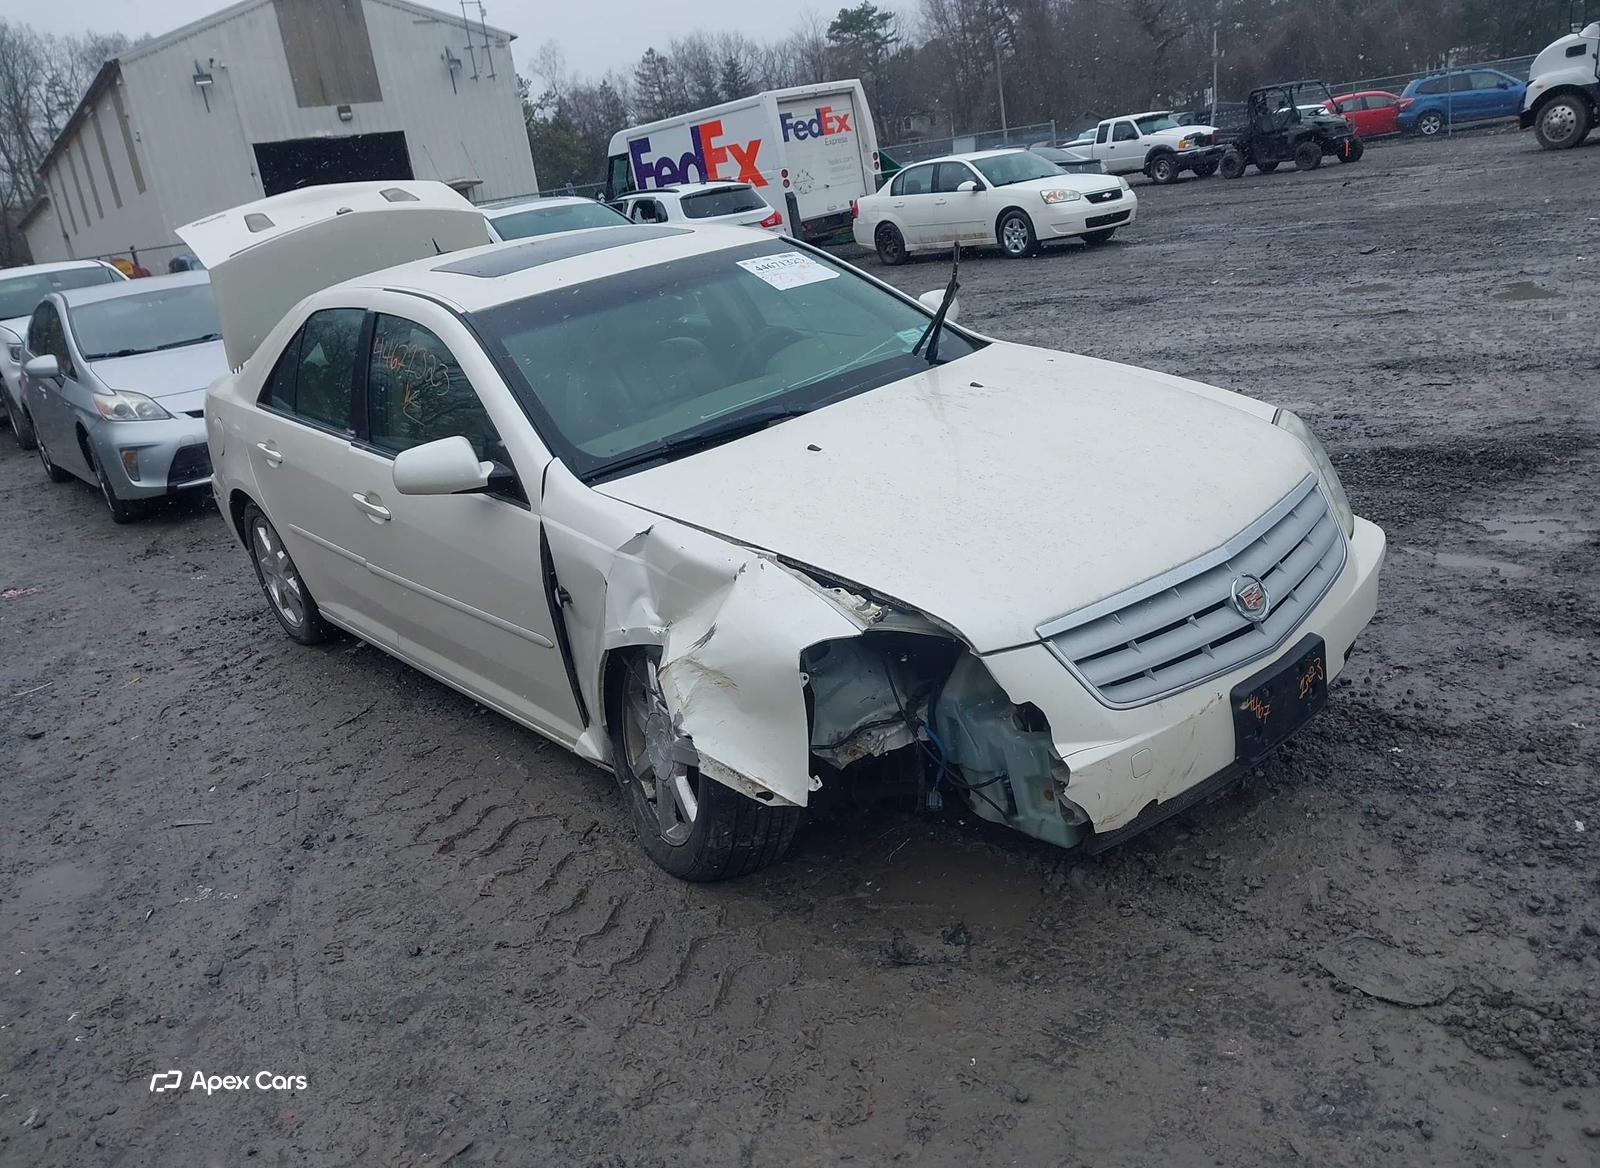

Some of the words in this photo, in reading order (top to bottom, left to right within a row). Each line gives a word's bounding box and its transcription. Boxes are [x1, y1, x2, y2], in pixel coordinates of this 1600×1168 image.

[780, 106, 852, 142] FedEx
[824, 137, 848, 146] Express
[629, 120, 769, 191] FedEx
